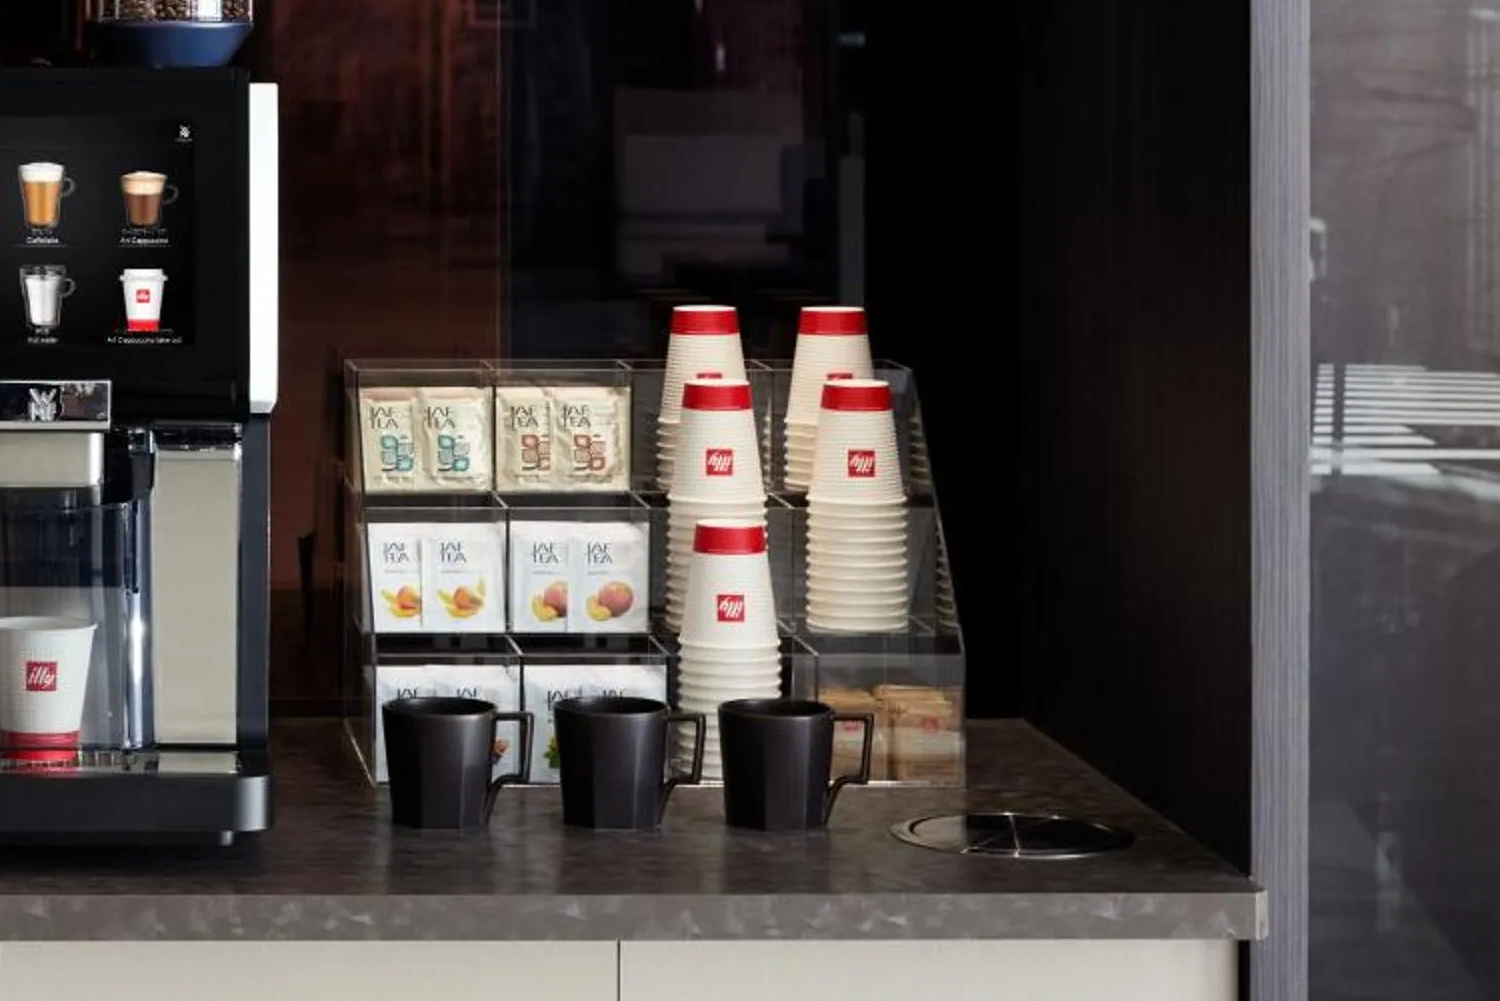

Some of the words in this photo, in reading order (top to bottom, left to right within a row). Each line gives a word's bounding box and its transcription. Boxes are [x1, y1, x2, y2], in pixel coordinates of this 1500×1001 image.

[849, 454, 874, 473] illy
[719, 597, 743, 619] illy
[28, 665, 55, 689] illy
